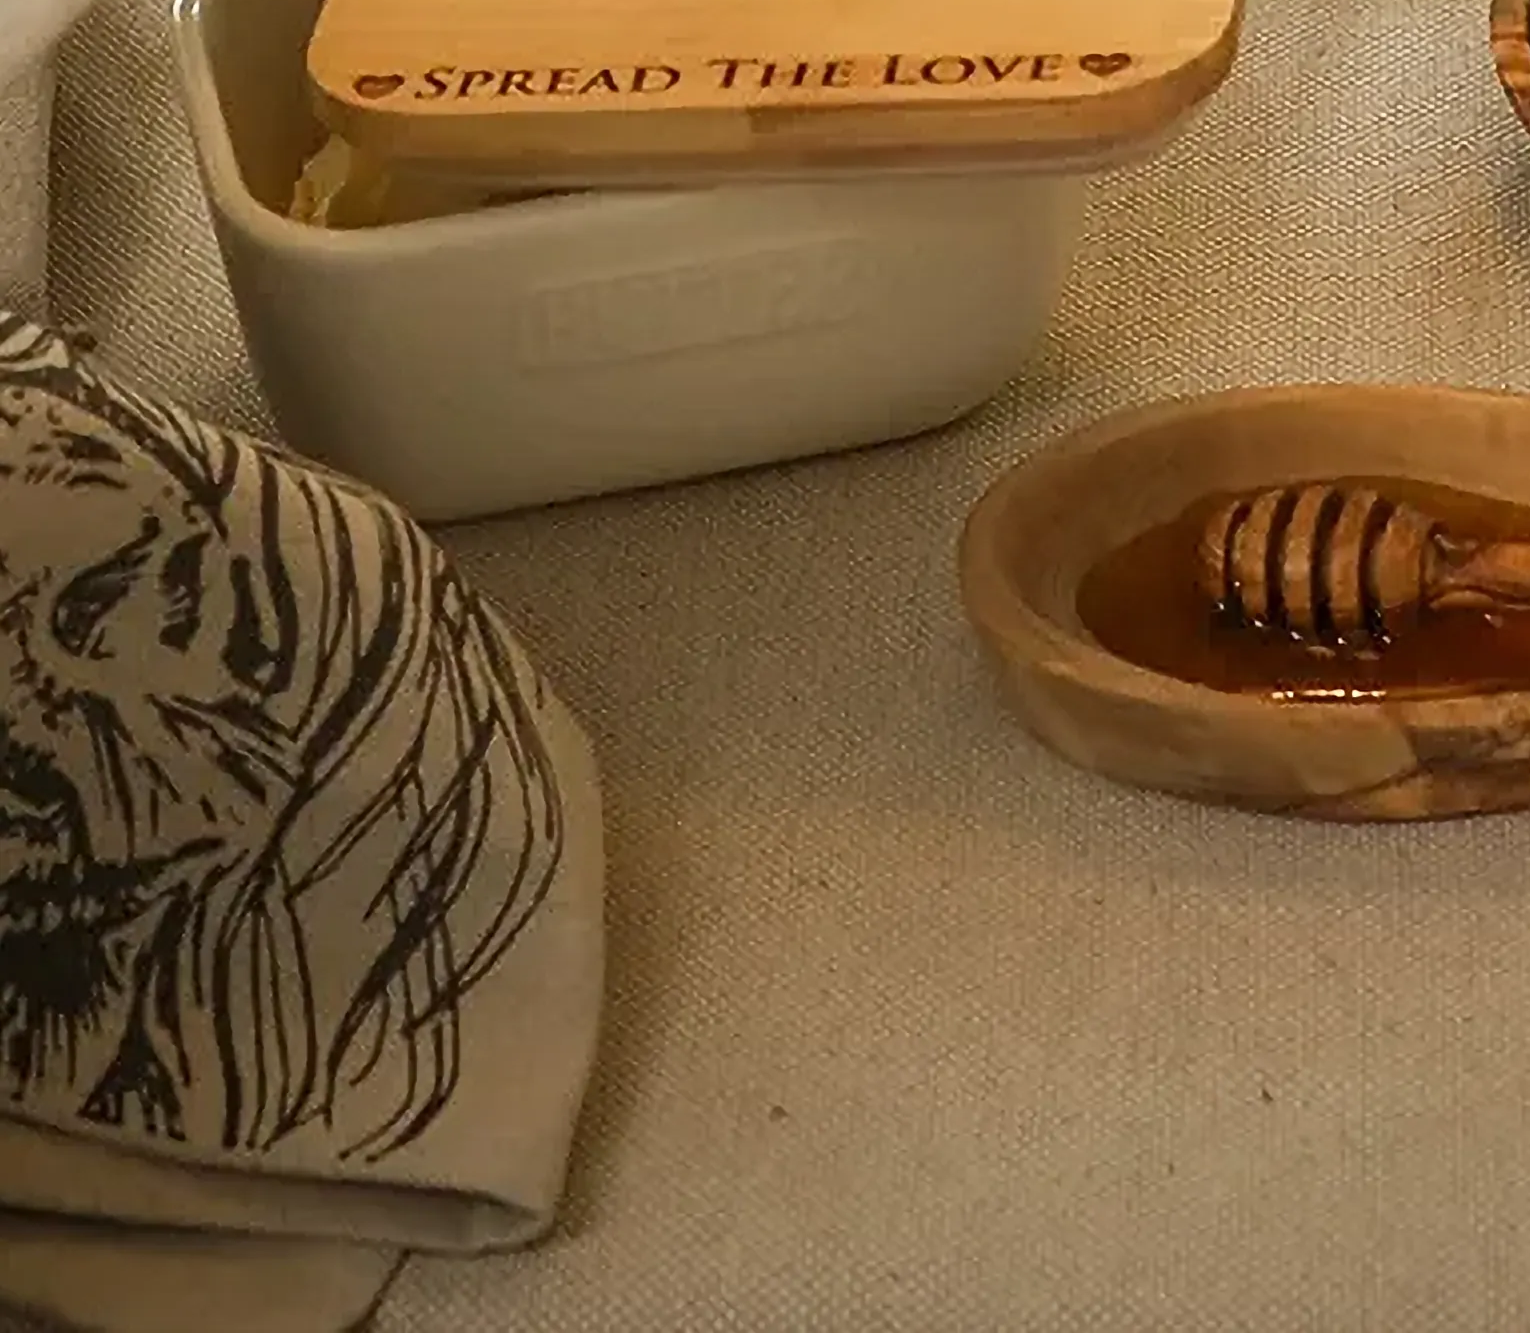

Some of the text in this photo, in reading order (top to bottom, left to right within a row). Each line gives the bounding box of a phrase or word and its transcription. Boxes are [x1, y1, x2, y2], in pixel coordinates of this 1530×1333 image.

[414, 53, 1063, 99] SPREAD THE LOVE
